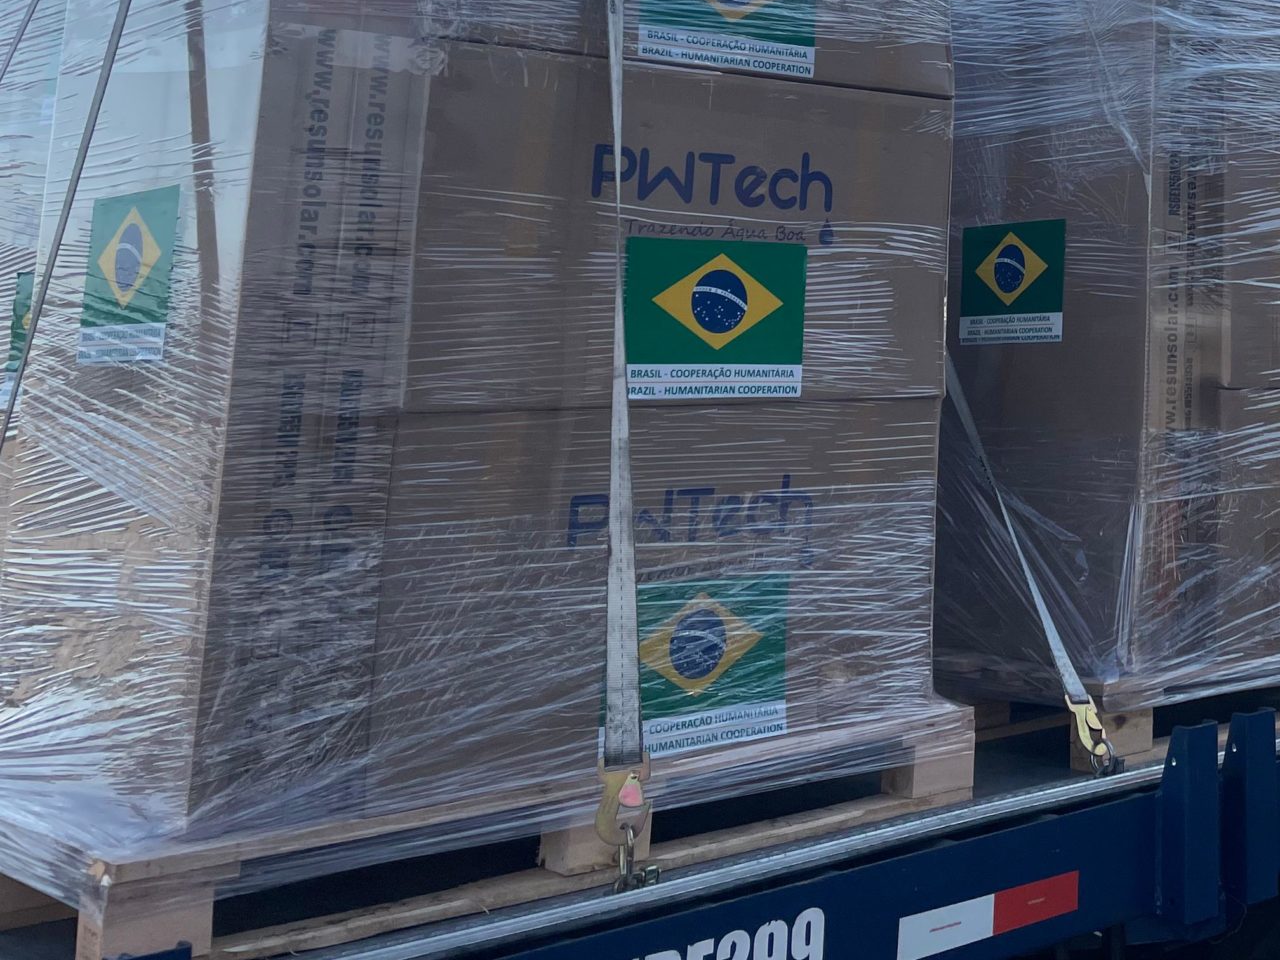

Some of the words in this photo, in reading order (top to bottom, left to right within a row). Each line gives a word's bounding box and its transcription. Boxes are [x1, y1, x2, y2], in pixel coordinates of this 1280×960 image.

[647, 30, 678, 43] BRASIL
[686, 35, 746, 51] COOPERAÇÃO
[748, 43, 808, 60] HUMANITÁRIA
[642, 46, 673, 58] BRAZIL
[681, 50, 750, 67] HUMANITARIAN
[752, 59, 811, 75] COOPERATION
[591, 144, 834, 213] PWTech
[624, 219, 714, 237] Trazendo
[721, 219, 768, 240] Água
[775, 226, 807, 241] Boa
[630, 369, 662, 378] BRASIL
[670, 367, 731, 380] COOPERAÇÃO
[734, 368, 794, 378] HUMANITÁRIA
[664, 385, 735, 396] HUMANITARIAN
[738, 385, 798, 395] COOPERATION
[645, 732, 718, 753] HUMANITARIAN
[720, 723, 784, 740] COOPERATION
